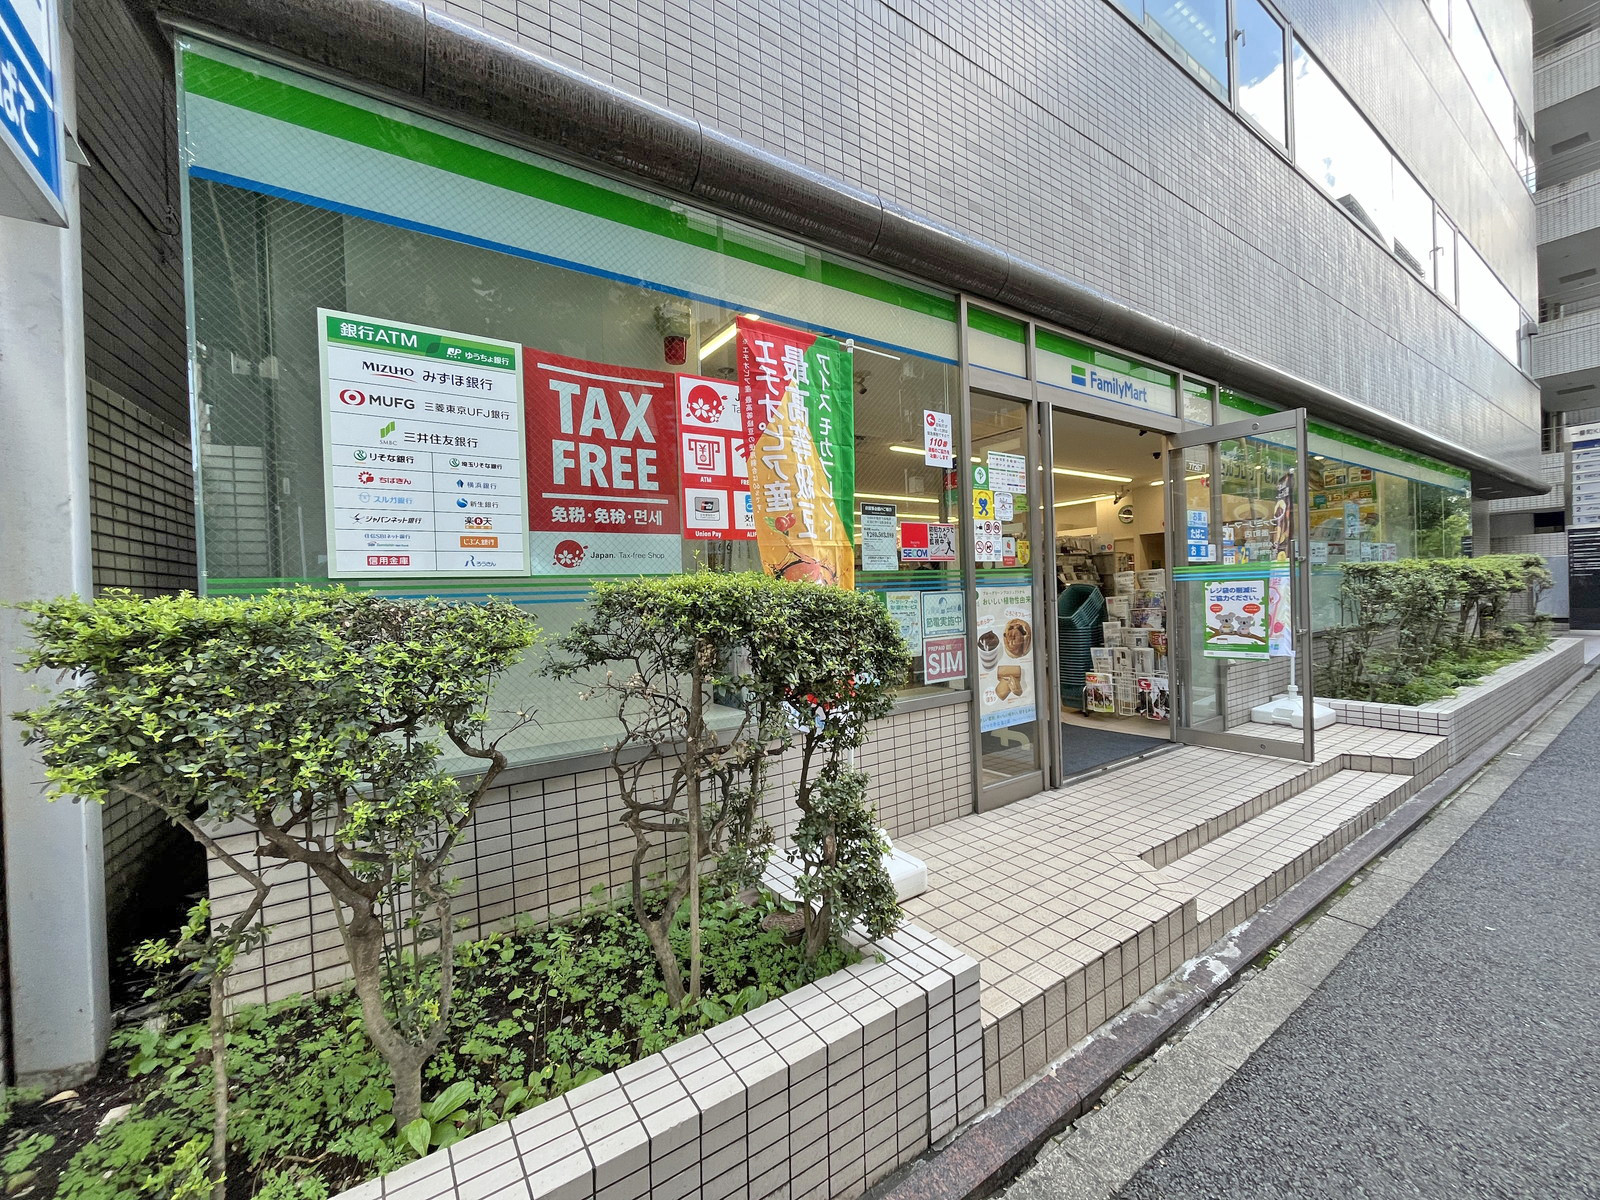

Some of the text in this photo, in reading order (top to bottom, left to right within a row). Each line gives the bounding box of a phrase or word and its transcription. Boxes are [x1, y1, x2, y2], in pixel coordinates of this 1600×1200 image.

[340, 322, 418, 348] 銀行ATM
[464, 351, 510, 366] ゆうちょ銀行
[362, 361, 414, 377] MIZUHO
[422, 370, 493, 391] みずほ銀行
[1090, 371, 1148, 403] FamilyMart
[369, 394, 416, 410] MUFG
[424, 402, 510, 420] 三菱東京UFJ銀行
[549, 378, 657, 444] TAX
[403, 431, 479, 448] 三井住友銀行
[369, 452, 415, 464] りそな銀行
[551, 438, 660, 491] FREE
[461, 460, 503, 470] 埼玉りそな銀行
[466, 481, 497, 490] 横浜銀行
[373, 495, 413, 505] スルガ銀行
[470, 500, 499, 509] 新生銀行
[365, 514, 422, 525] ジャパンネット銀行
[1190, 528, 1206, 539] たばこ
[590, 551, 665, 560] Japan. Tax-free Shop
[903, 549, 928, 558] SECOM
[368, 556, 409, 566] 信用金庫
[1209, 586, 1257, 594] レジ袋の削減に
[928, 650, 963, 676] SIM
